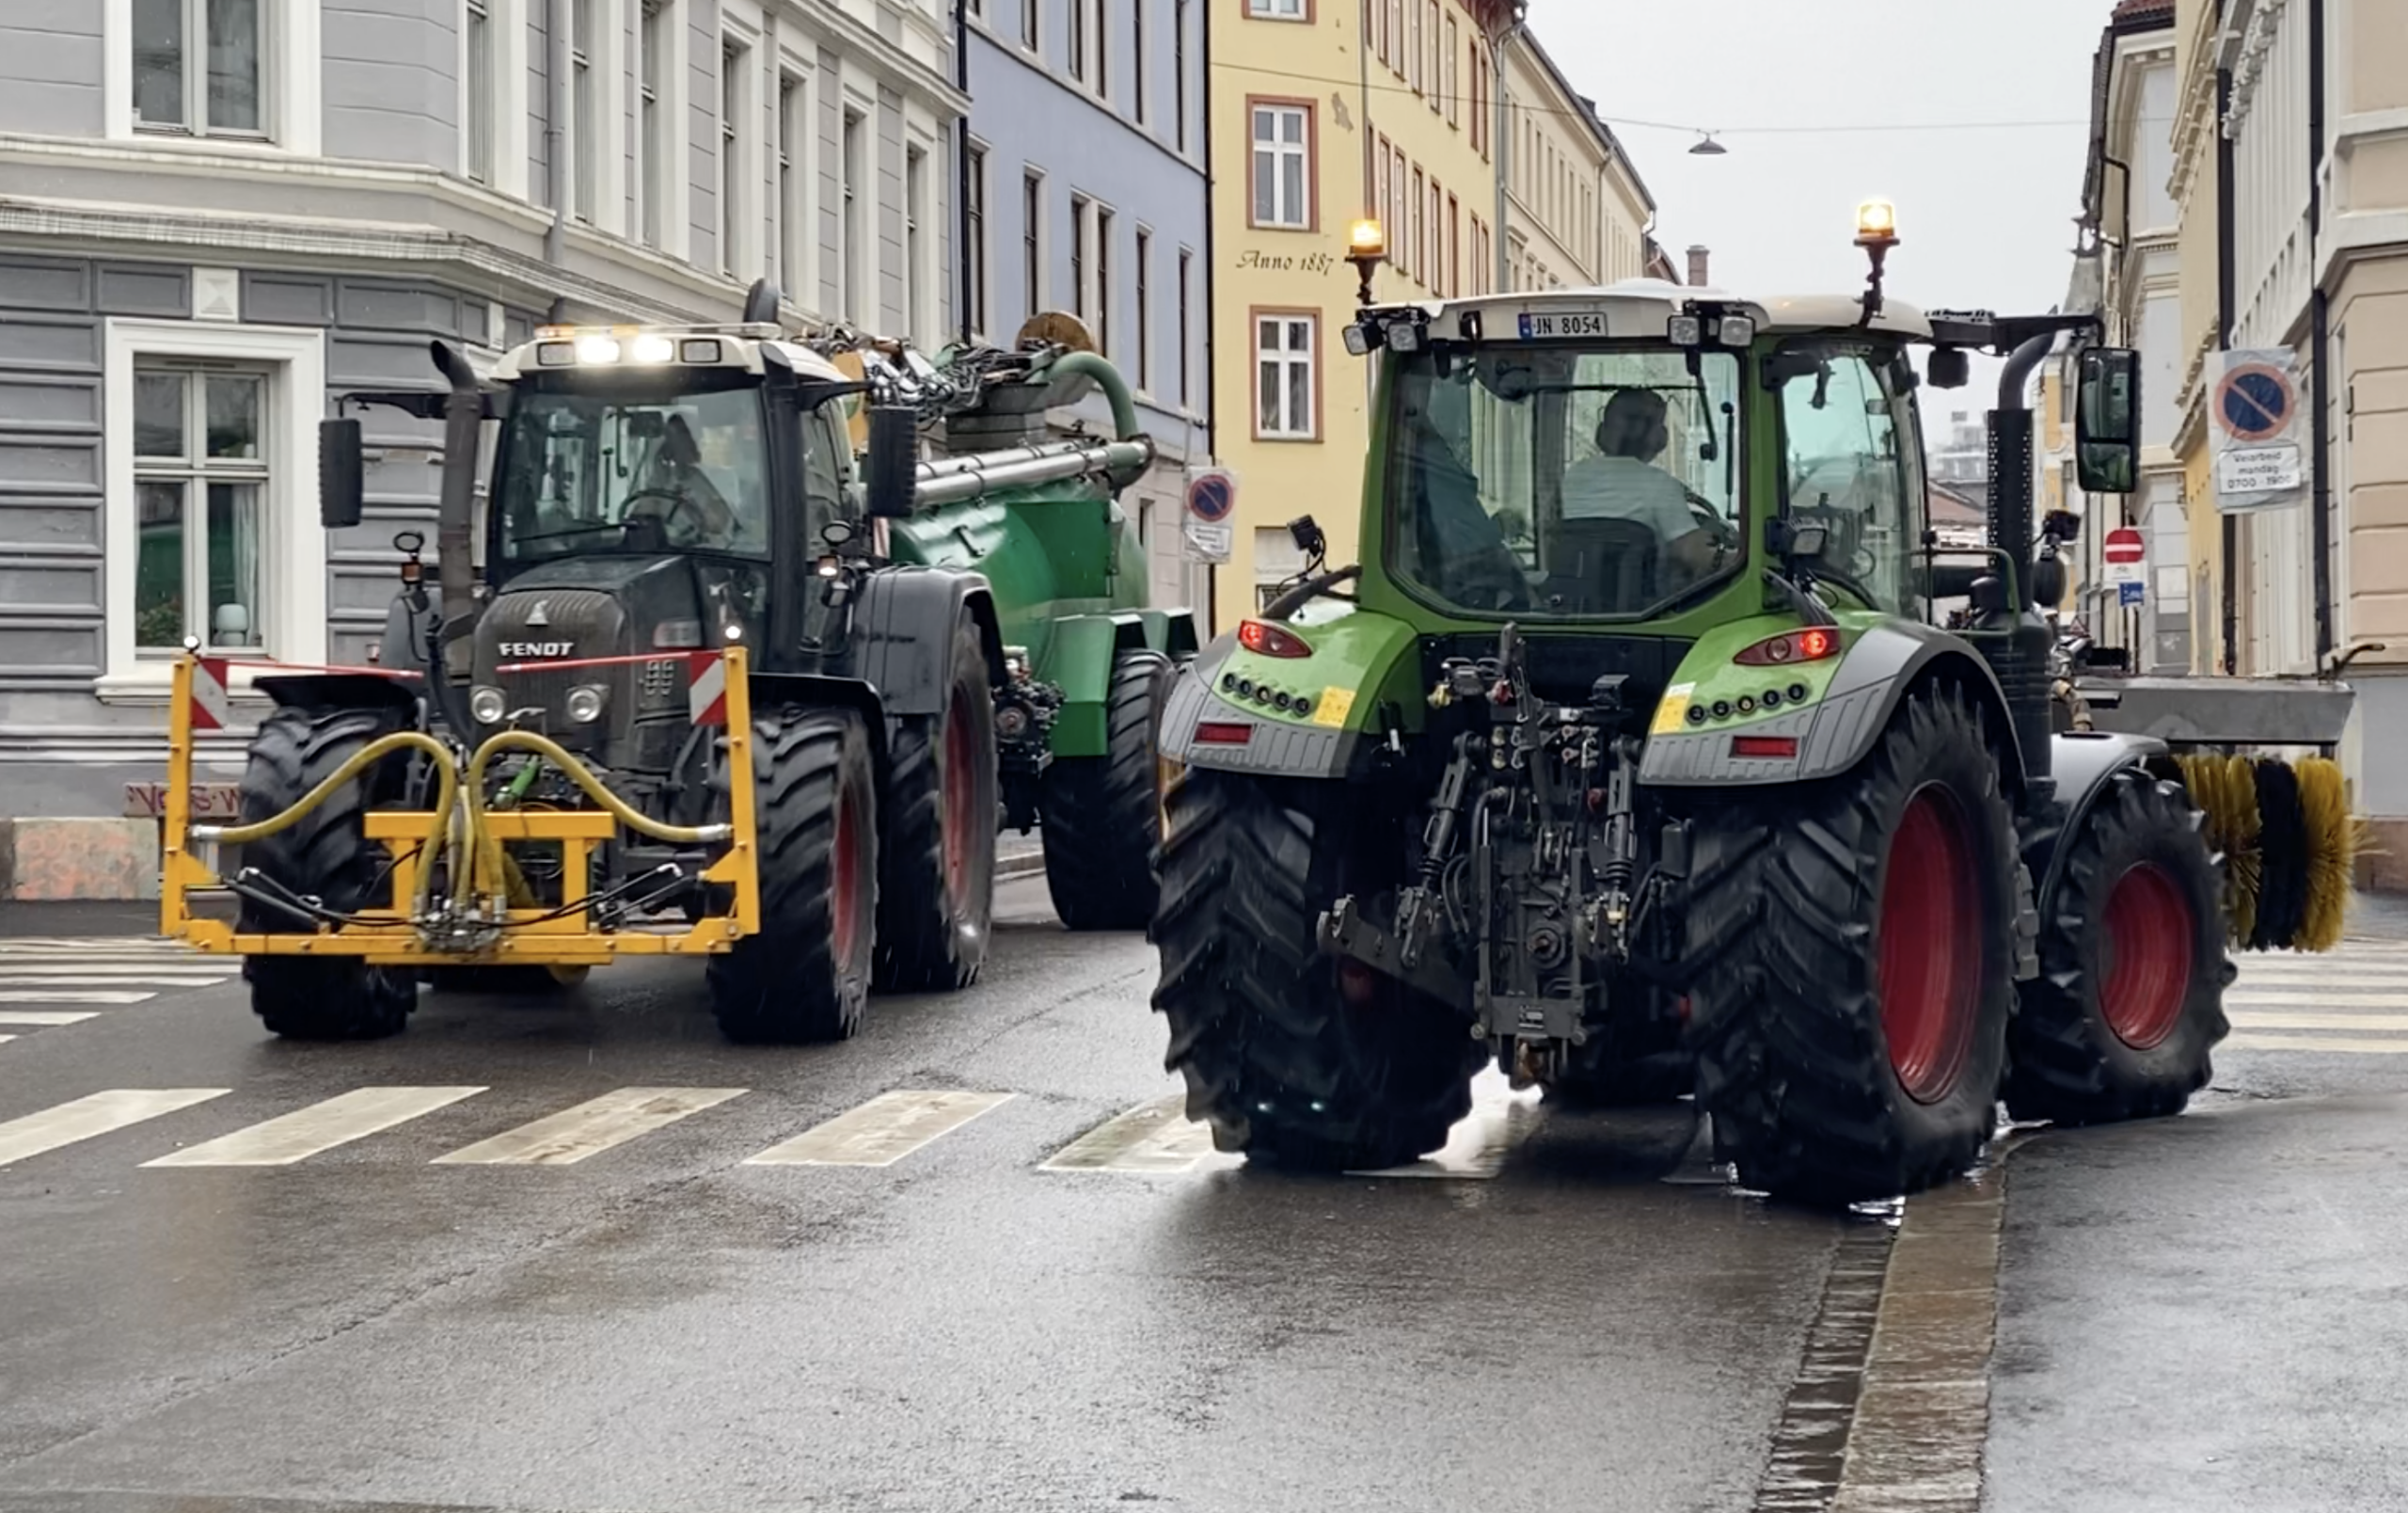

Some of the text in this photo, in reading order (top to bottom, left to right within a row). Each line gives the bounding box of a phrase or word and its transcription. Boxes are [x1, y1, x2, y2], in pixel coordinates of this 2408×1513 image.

[1236, 250, 1334, 276] Anno 1887
[1535, 316, 1601, 335] JN 8054
[2227, 477, 2257, 488] 0700
[499, 642, 574, 656] FENDT
